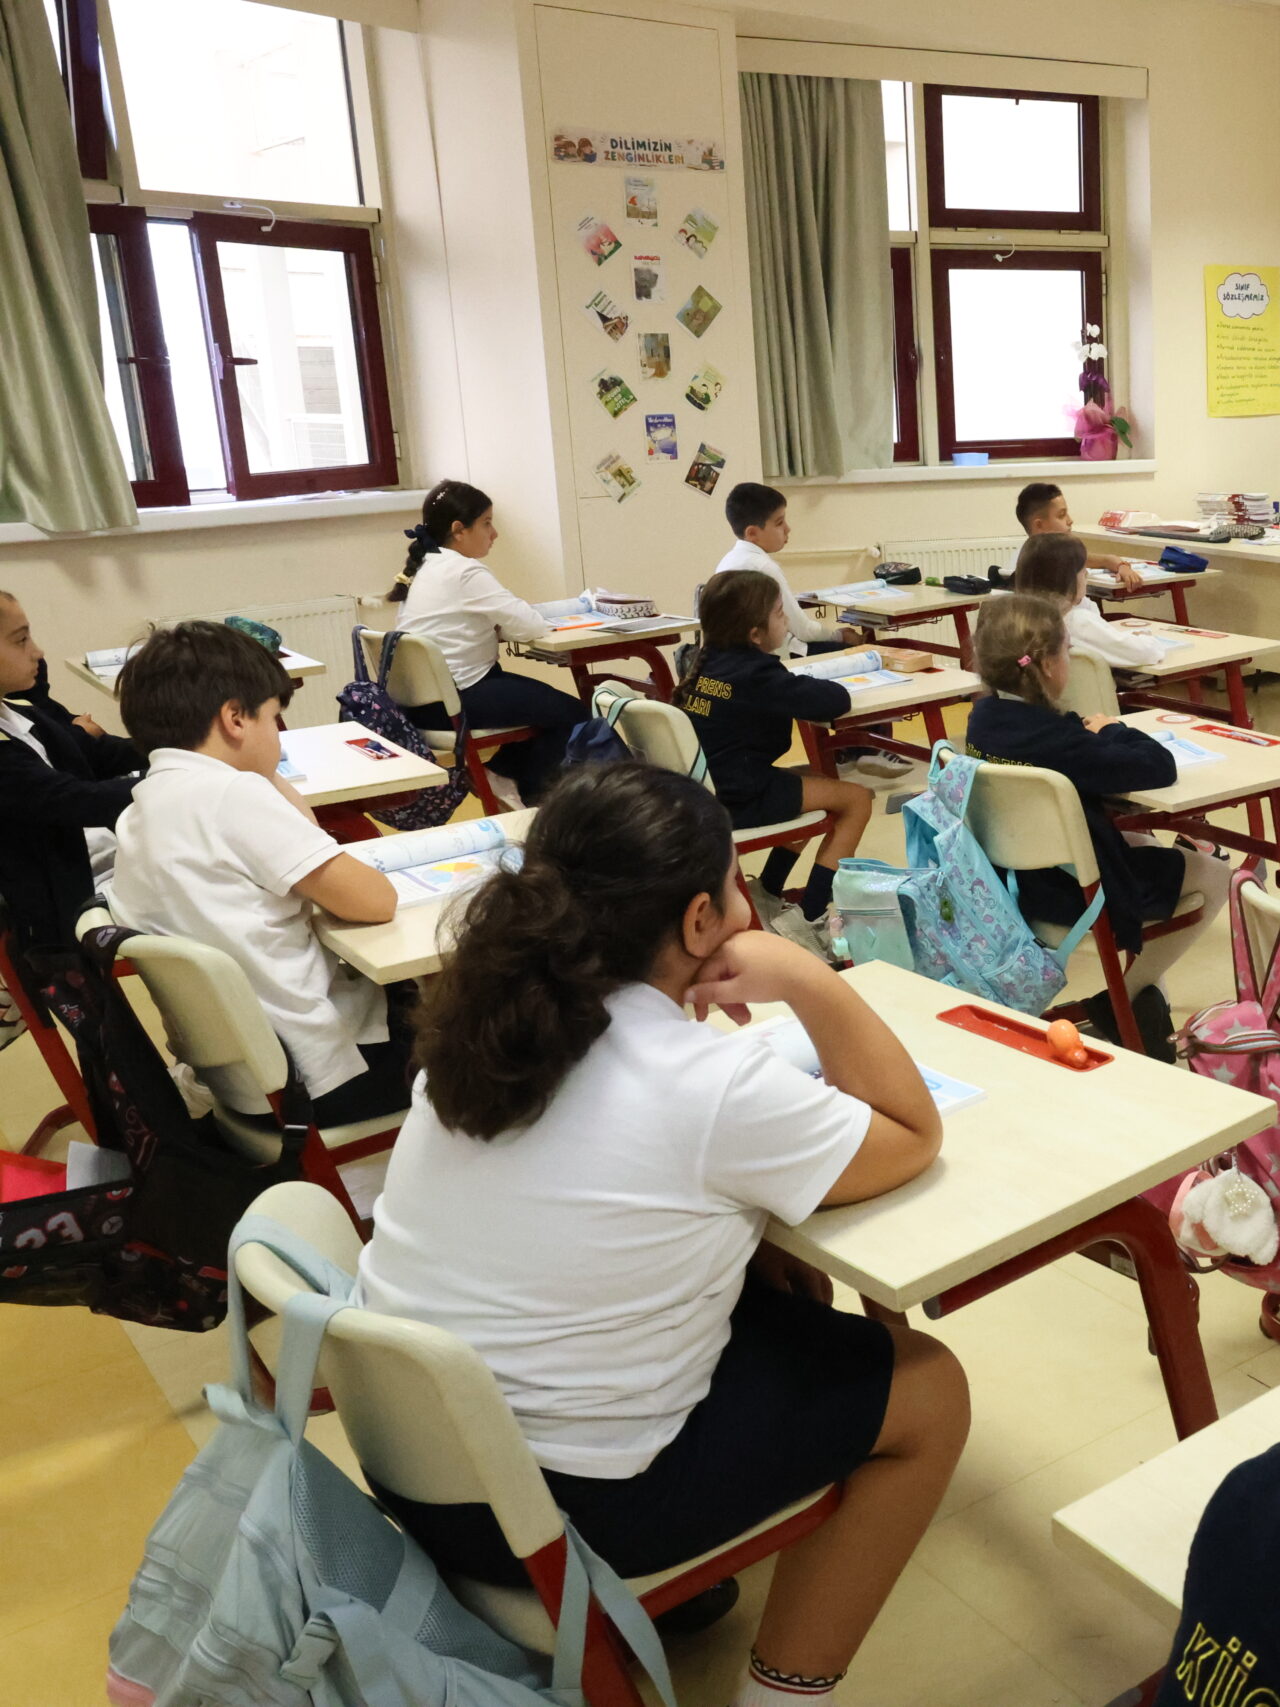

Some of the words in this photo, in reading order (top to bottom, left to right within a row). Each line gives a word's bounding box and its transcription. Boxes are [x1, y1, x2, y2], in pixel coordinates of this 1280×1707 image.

[610, 137, 672, 152] DİLİMİZİN
[695, 675, 732, 700] PRENS
[683, 694, 712, 717] LARI
